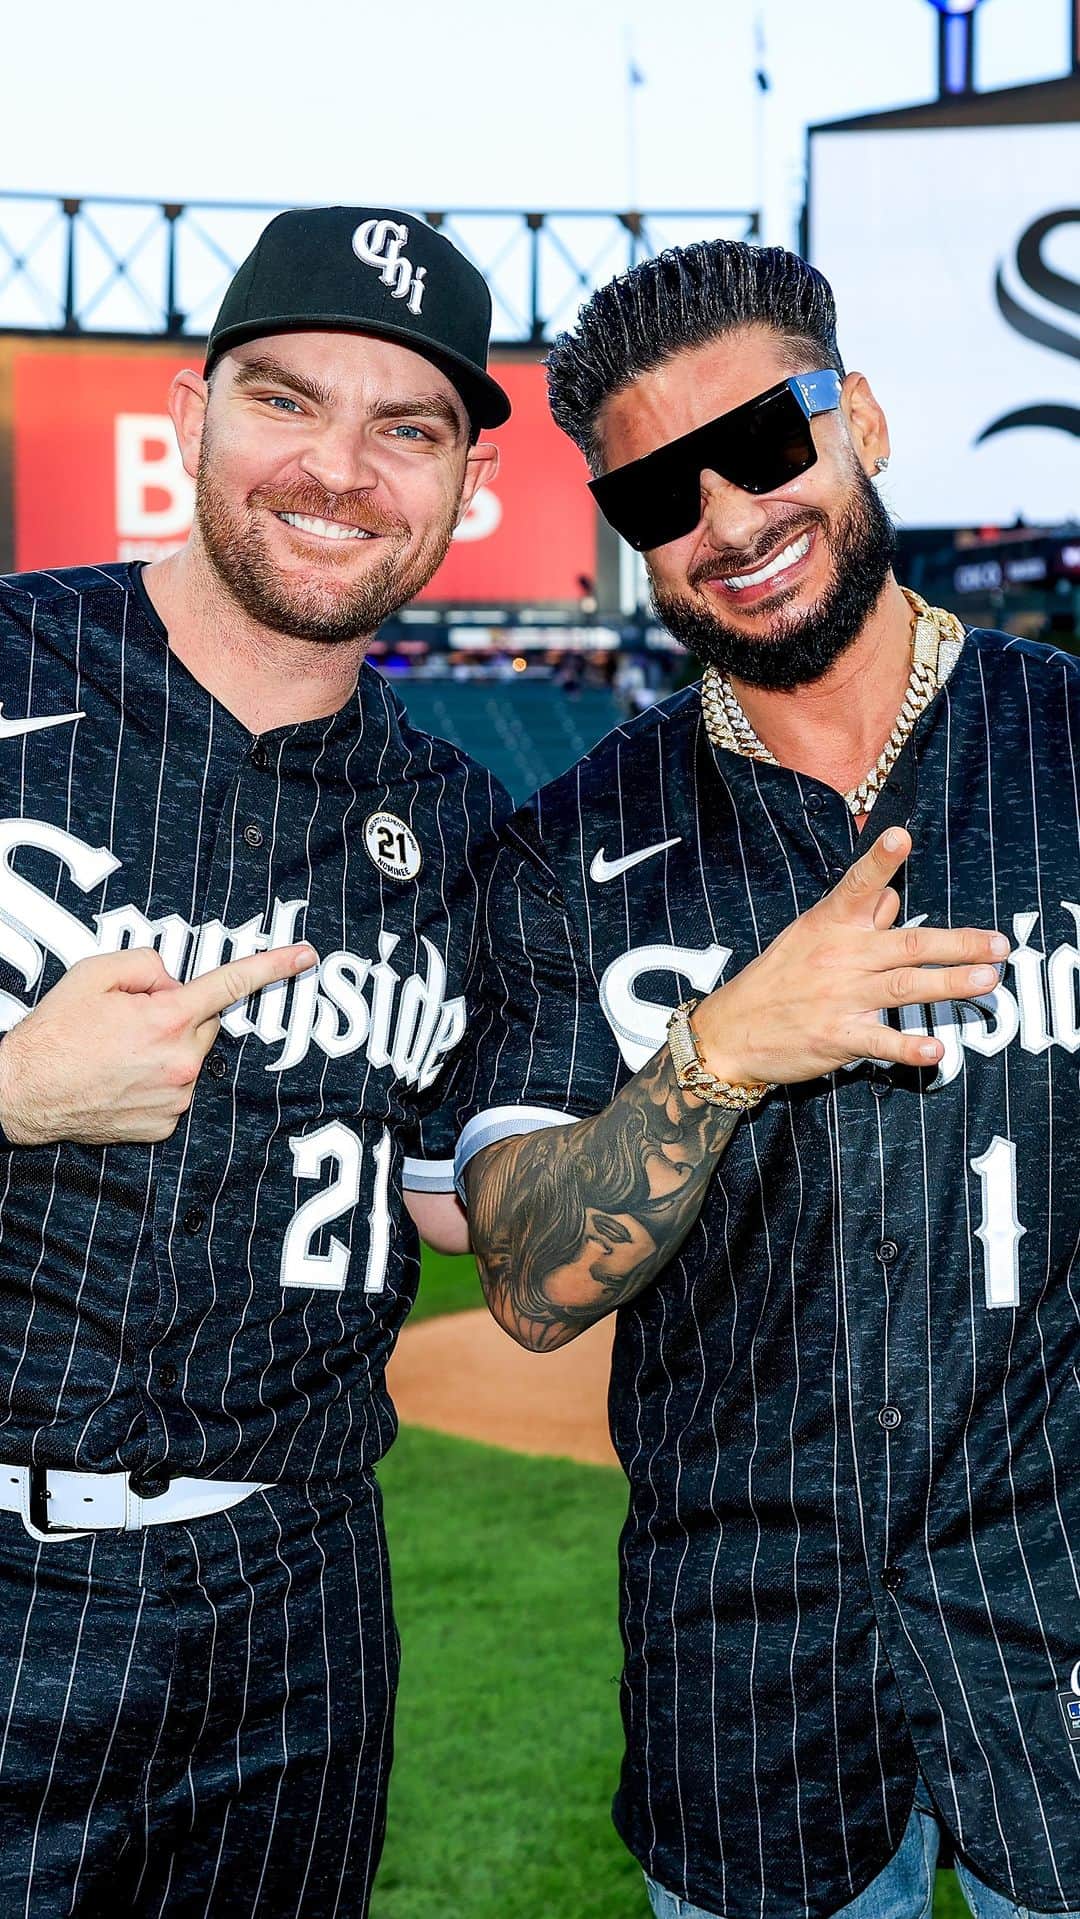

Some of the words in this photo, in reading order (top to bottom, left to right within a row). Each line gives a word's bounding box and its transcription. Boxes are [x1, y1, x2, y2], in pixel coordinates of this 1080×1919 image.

[352, 219, 427, 315] Chi
[377, 826, 407, 864] 21
[378, 858, 411, 876] NOMINEE
[280, 1119, 392, 1294] 21
[970, 1135, 1027, 1310] 1
